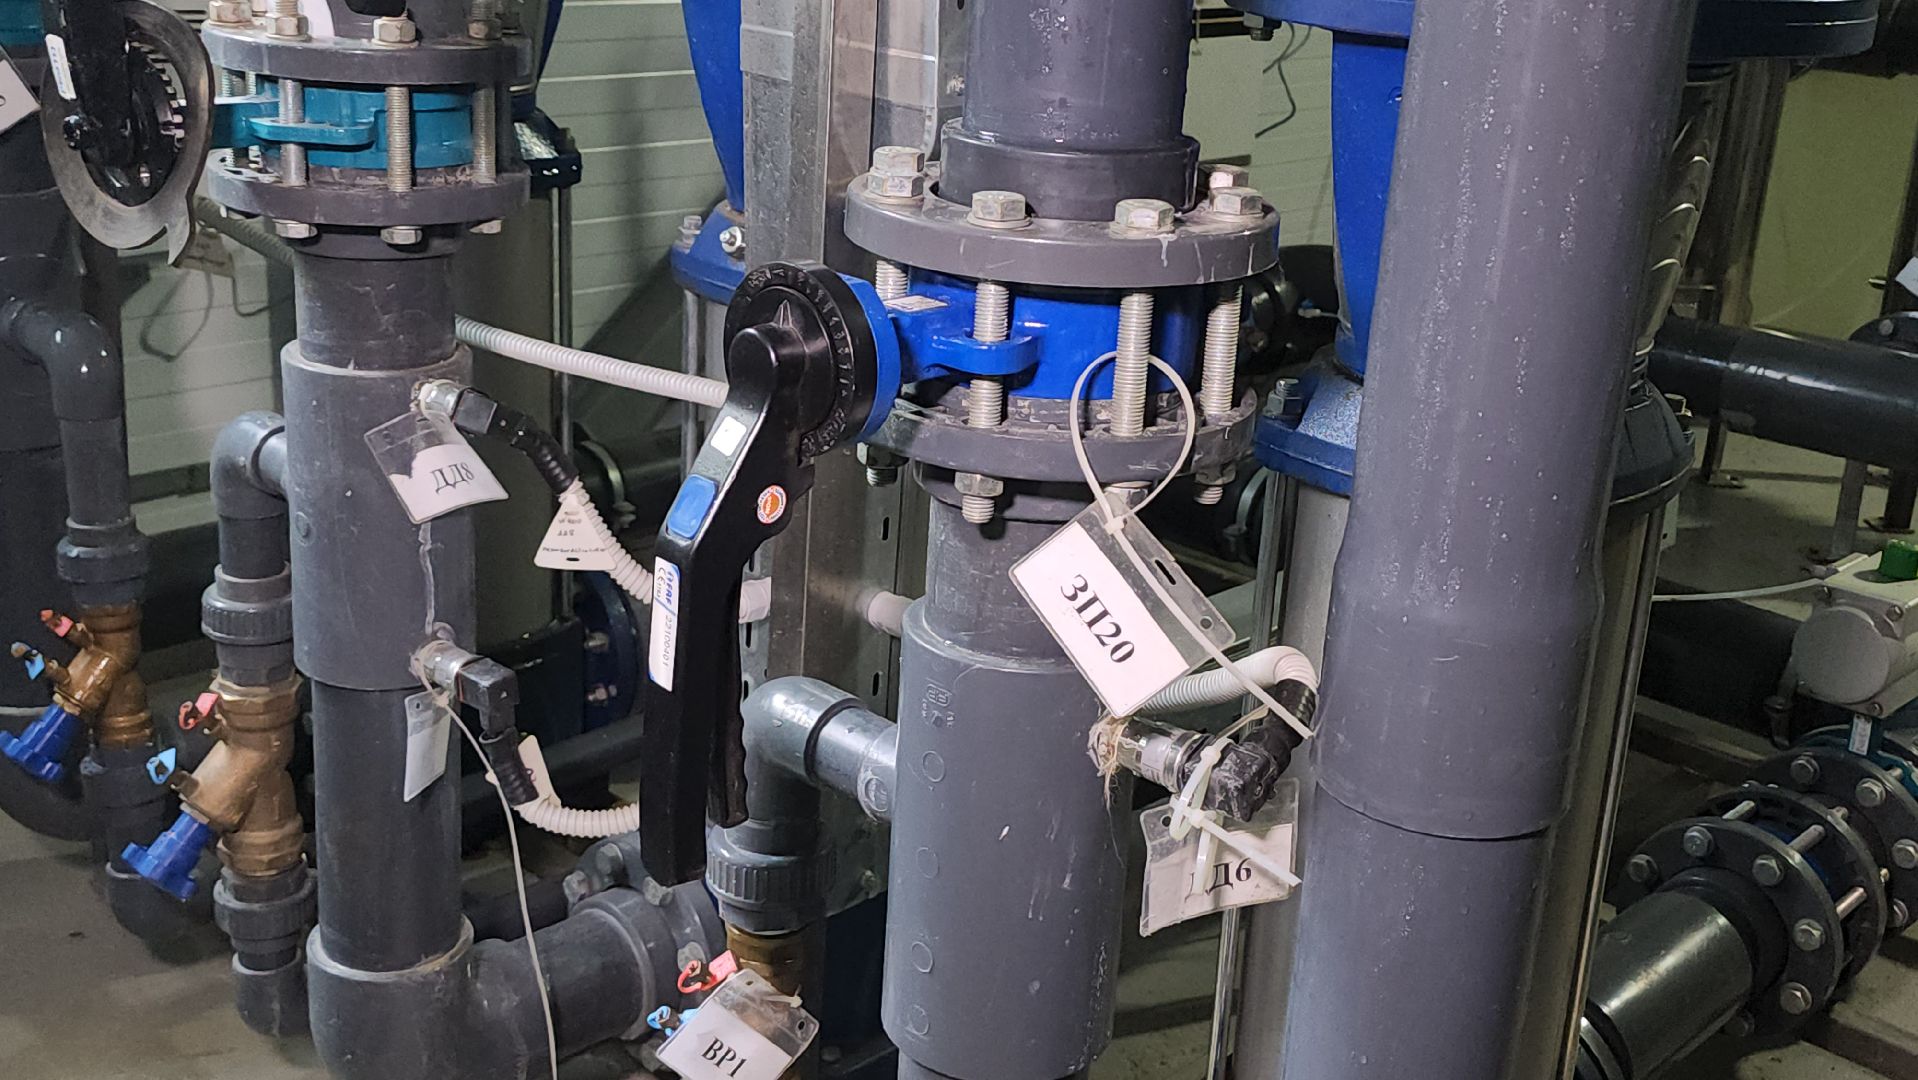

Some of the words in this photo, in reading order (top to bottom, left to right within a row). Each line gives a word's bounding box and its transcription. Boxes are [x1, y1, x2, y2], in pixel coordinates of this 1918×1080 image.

[430, 462, 474, 494] ДД8
[1060, 574, 1135, 663] ЗП20
[1184, 858, 1252, 903] Д6
[701, 1036, 747, 1078] ВР1
